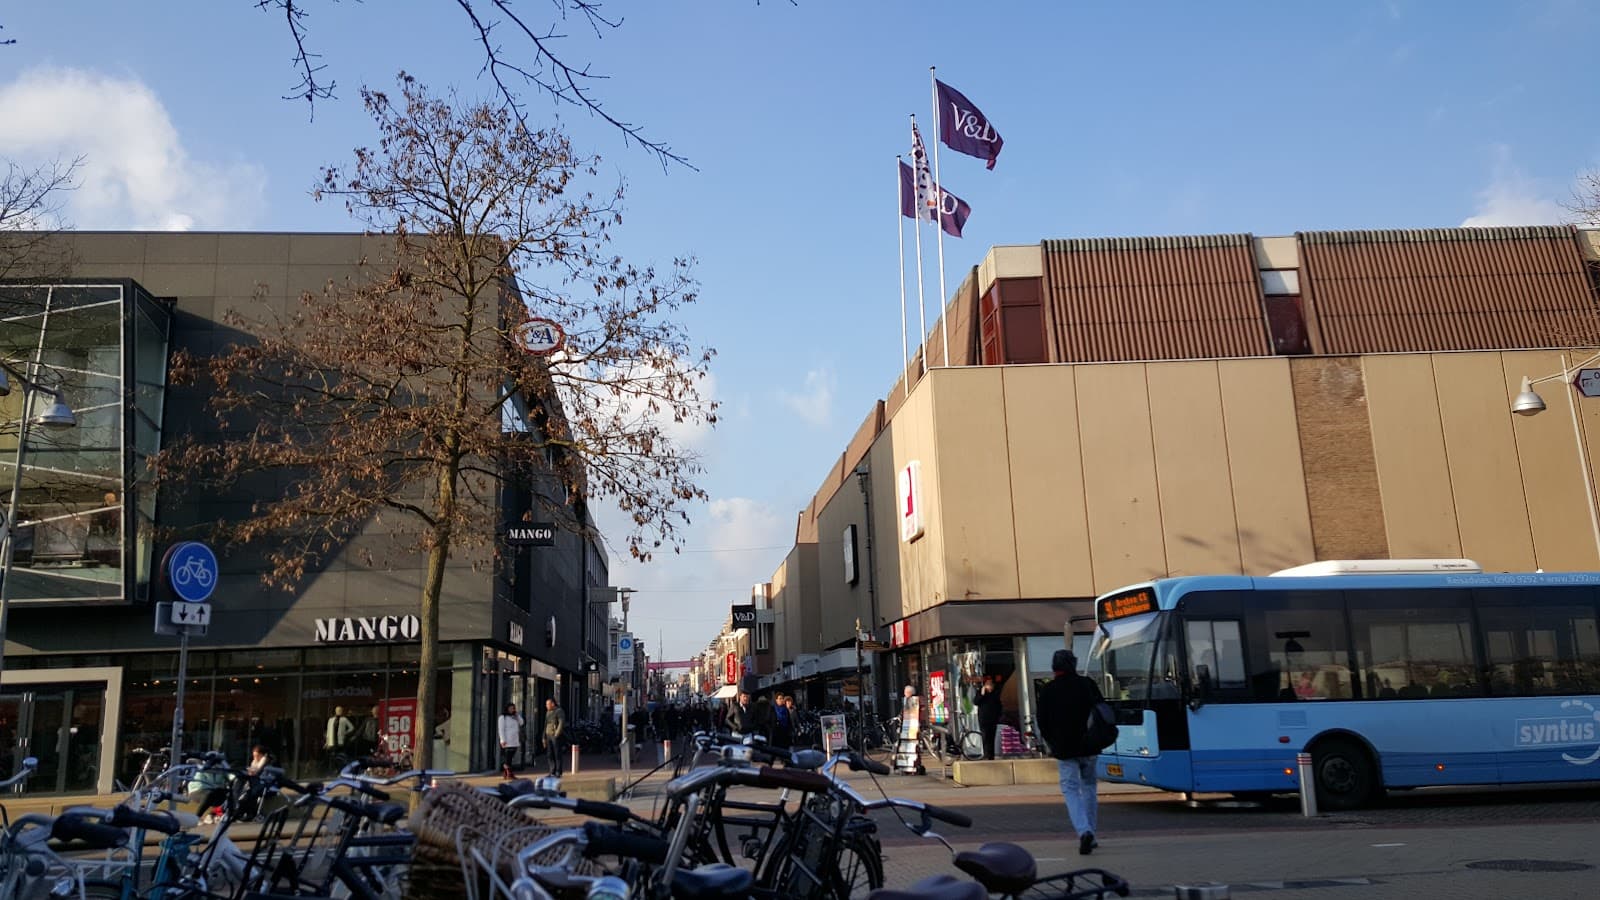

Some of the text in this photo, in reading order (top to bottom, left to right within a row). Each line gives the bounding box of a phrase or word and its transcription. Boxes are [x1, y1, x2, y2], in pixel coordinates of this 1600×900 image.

[950, 102, 998, 143] V&D
[508, 528, 552, 539] MANGO
[734, 612, 755, 621] V&D
[314, 614, 420, 642] MANGO
[388, 715, 411, 733] 50
[1519, 719, 1595, 744] syntus
[388, 734, 411, 753] 60
